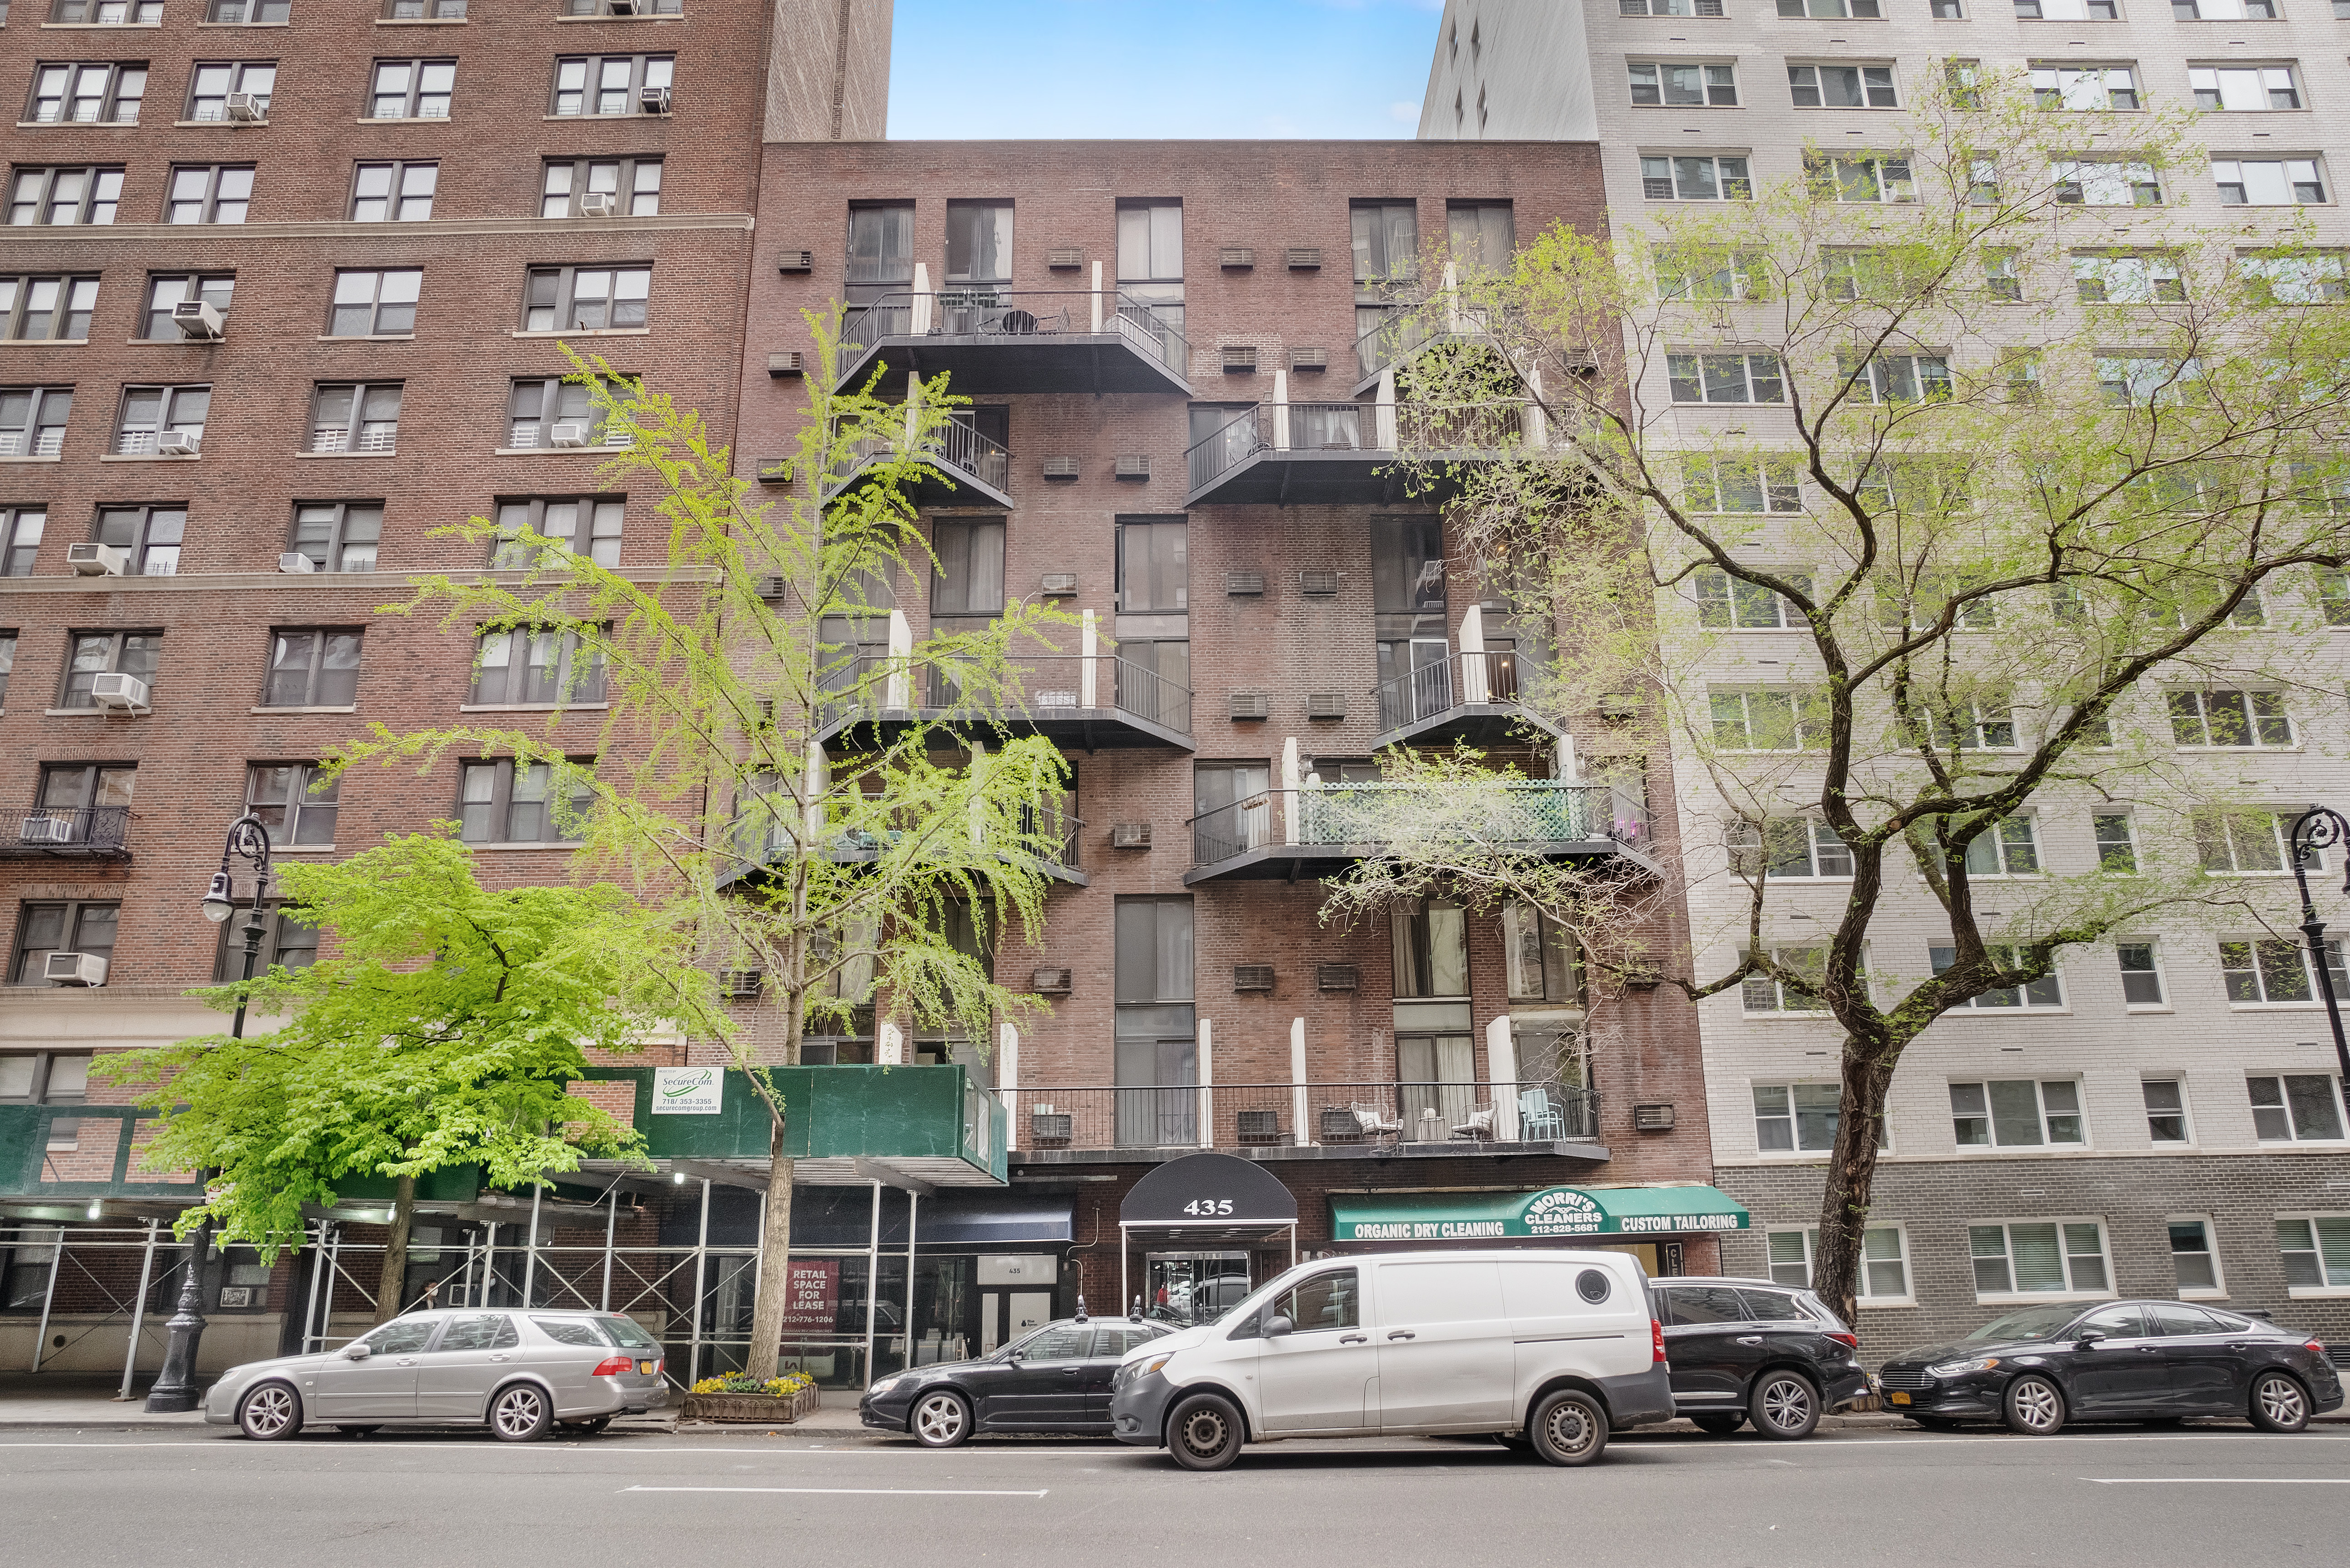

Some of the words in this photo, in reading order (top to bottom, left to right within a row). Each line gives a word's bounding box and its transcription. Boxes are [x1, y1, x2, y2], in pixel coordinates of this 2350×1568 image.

[663, 1077, 712, 1086] SecureCom
[1184, 1199, 1233, 1216] 435
[1529, 1192, 1596, 1215] MORRI'S
[1525, 1212, 1603, 1225] CLEANERS
[1622, 1216, 1671, 1231] CUSTOM
[1674, 1214, 1738, 1229] TAILORING
[1355, 1223, 1411, 1238] ORGANIC
[1414, 1223, 1439, 1238] DRY
[1441, 1221, 1505, 1237] CLEANING
[1531, 1223, 1599, 1234] 212-828-5681
[793, 1270, 828, 1279] RETAIL
[793, 1280, 826, 1289] SPACE
[798, 1290, 820, 1300] FOR
[793, 1301, 825, 1310] LEASE
